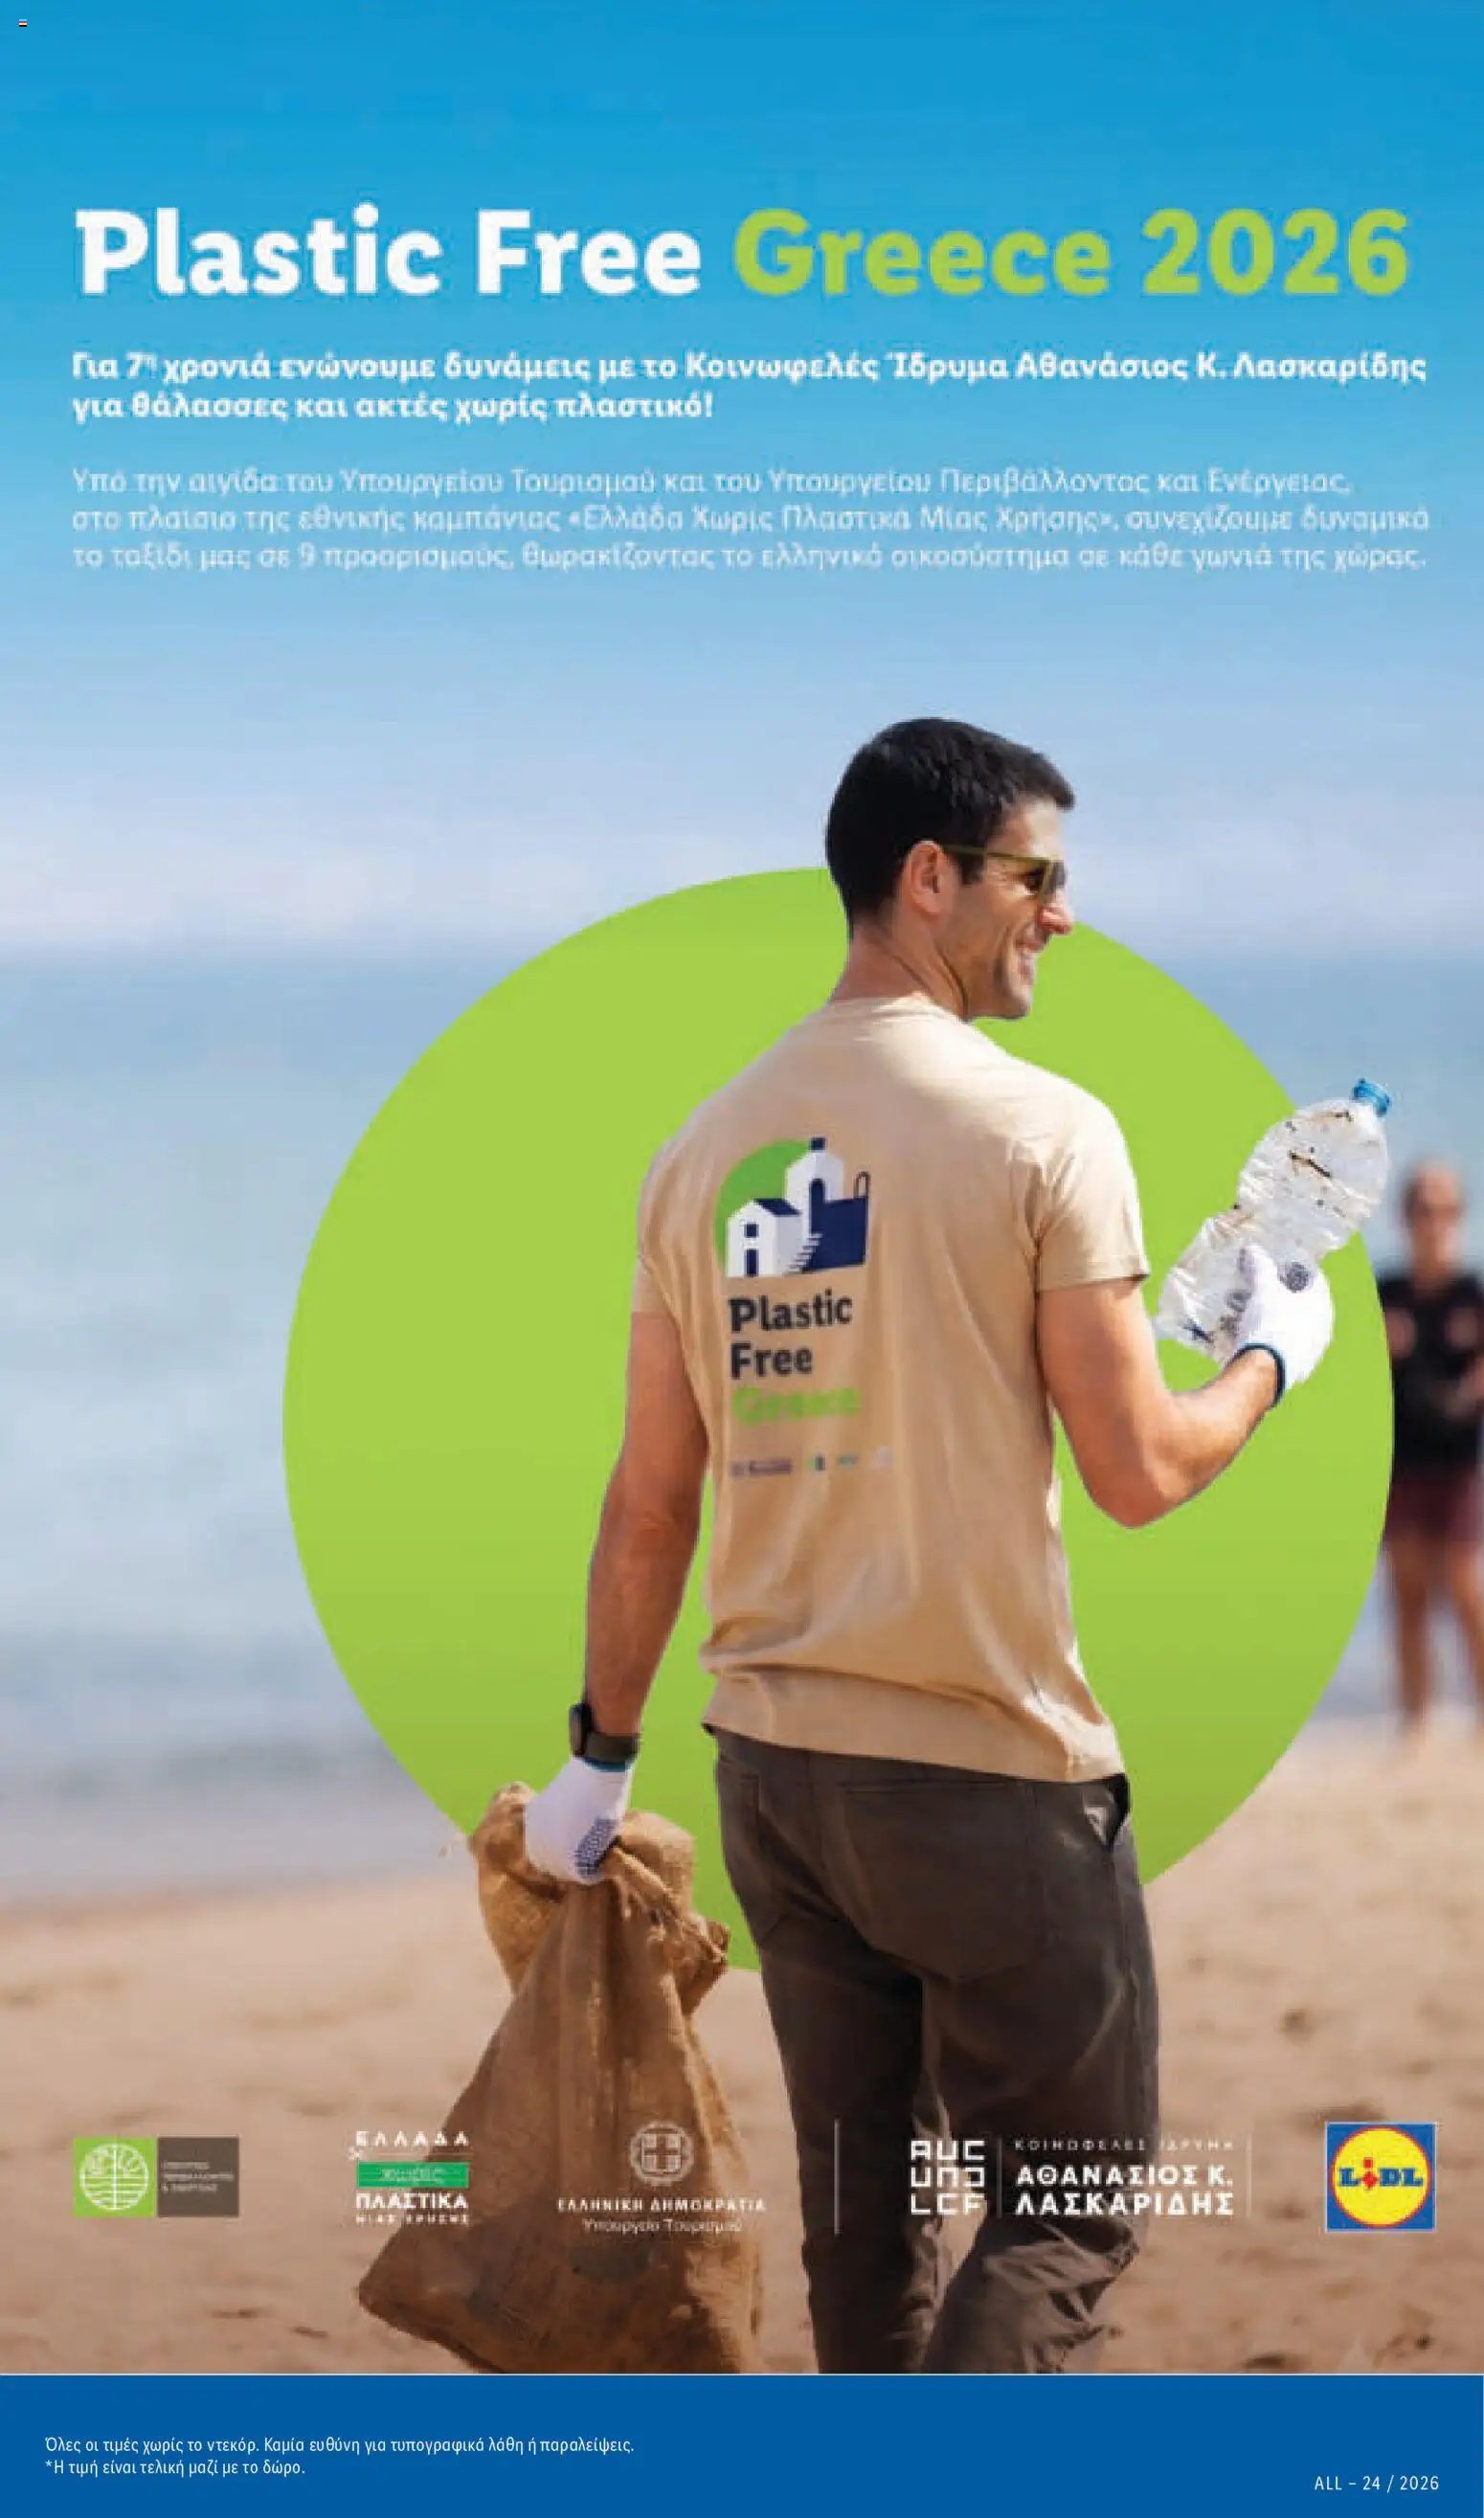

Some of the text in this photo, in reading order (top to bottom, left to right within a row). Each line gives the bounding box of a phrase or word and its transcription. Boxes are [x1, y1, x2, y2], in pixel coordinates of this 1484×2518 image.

[76, 203, 1409, 296] Plastic Free Greece 2026
[73, 352, 118, 379] Για
[163, 350, 270, 385] χρονιά
[281, 352, 435, 384] ενώνουμε
[444, 350, 591, 384] δυνάμεις
[599, 358, 634, 384] με
[642, 360, 676, 379] το
[686, 350, 878, 384] Κοινωφελές
[1016, 350, 1188, 380] Αθανάσιος
[1197, 351, 1225, 379] Κ.
[1233, 351, 1426, 385] Λασκαρίδης
[73, 391, 712, 423] για θάλασσες και ακτές χωρίς πλαστικό!
[73, 468, 126, 492] Υπό
[134, 474, 180, 498] την
[190, 466, 278, 497] αιγίδα
[286, 474, 333, 492] του
[340, 468, 504, 498] Υπουργείου
[511, 467, 654, 499] Τουρισμού
[663, 474, 705, 492] και
[714, 474, 761, 492] του
[769, 469, 931, 498] Υπουργείου
[941, 467, 1149, 498] Περιβάλλοντος
[1158, 474, 1199, 492] και
[73, 511, 121, 532] στο
[128, 504, 236, 531] πλαίσιο
[244, 511, 289, 534] της
[299, 503, 405, 536] εθνικής
[414, 505, 561, 535] καμπάνιας
[691, 505, 773, 535] Χωρίς
[782, 504, 911, 531] Πλαστικά
[921, 505, 987, 531] Μίας
[1126, 503, 1292, 535] συνεχίζουμε
[1301, 504, 1428, 534] δυναμικά
[74, 540, 1425, 574] το ταξίδι μας σε 9 προορισμούς, θωρακίζοντας το ελληνικό οικοσύστημα σε κάθε γωνιά της χώρας.
[729, 1288, 852, 1333] Plastic
[731, 1342, 813, 1379] Free
[356, 2130, 469, 2147] ΕΛΛΑΔΑ
[1016, 2164, 1234, 2186] ΑΘΑΝΑΣΙΟΣ Κ.
[355, 2192, 469, 2209] ΠΛΑΣΤΙΚΑ
[1015, 2192, 1234, 2215] ΛΑΣΚΑΡΙΔΗΣ
[45, 2437, 634, 2455] Όλες οι τιμές χωρίς το ντεκόρ. Καμία ευθύνη για τυπογραφικά λάθη ή παραλείψεις.
[69, 2460, 98, 2478] τιμή
[103, 2460, 136, 2473] είναι
[140, 2460, 184, 2477] τελική
[190, 2460, 218, 2477] μαζί
[223, 2463, 237, 2477] με
[242, 2463, 258, 2474] το
[263, 2460, 304, 2477] δώρο.
[1315, 2476, 1342, 2490] ALL
[1363, 2476, 1380, 2490] 24
[1401, 2476, 1438, 2490] 2026
